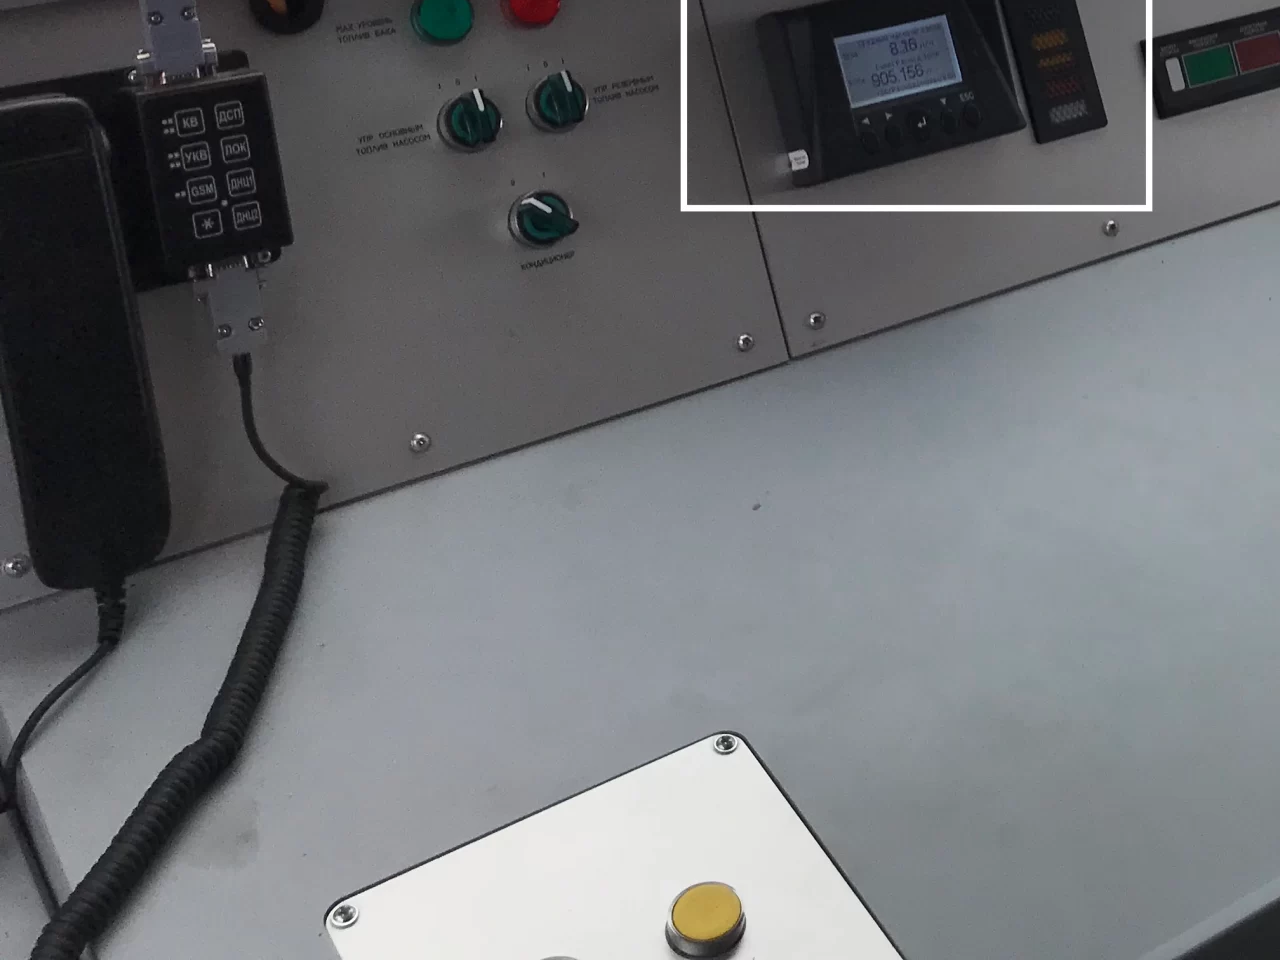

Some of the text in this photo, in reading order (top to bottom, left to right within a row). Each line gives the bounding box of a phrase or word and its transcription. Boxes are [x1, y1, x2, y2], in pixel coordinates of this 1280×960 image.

[960, 91, 975, 103] ESC
[182, 116, 199, 129] КВ
[218, 107, 241, 123] ДСП
[184, 148, 208, 163] УКВ
[191, 183, 214, 198] GSM
